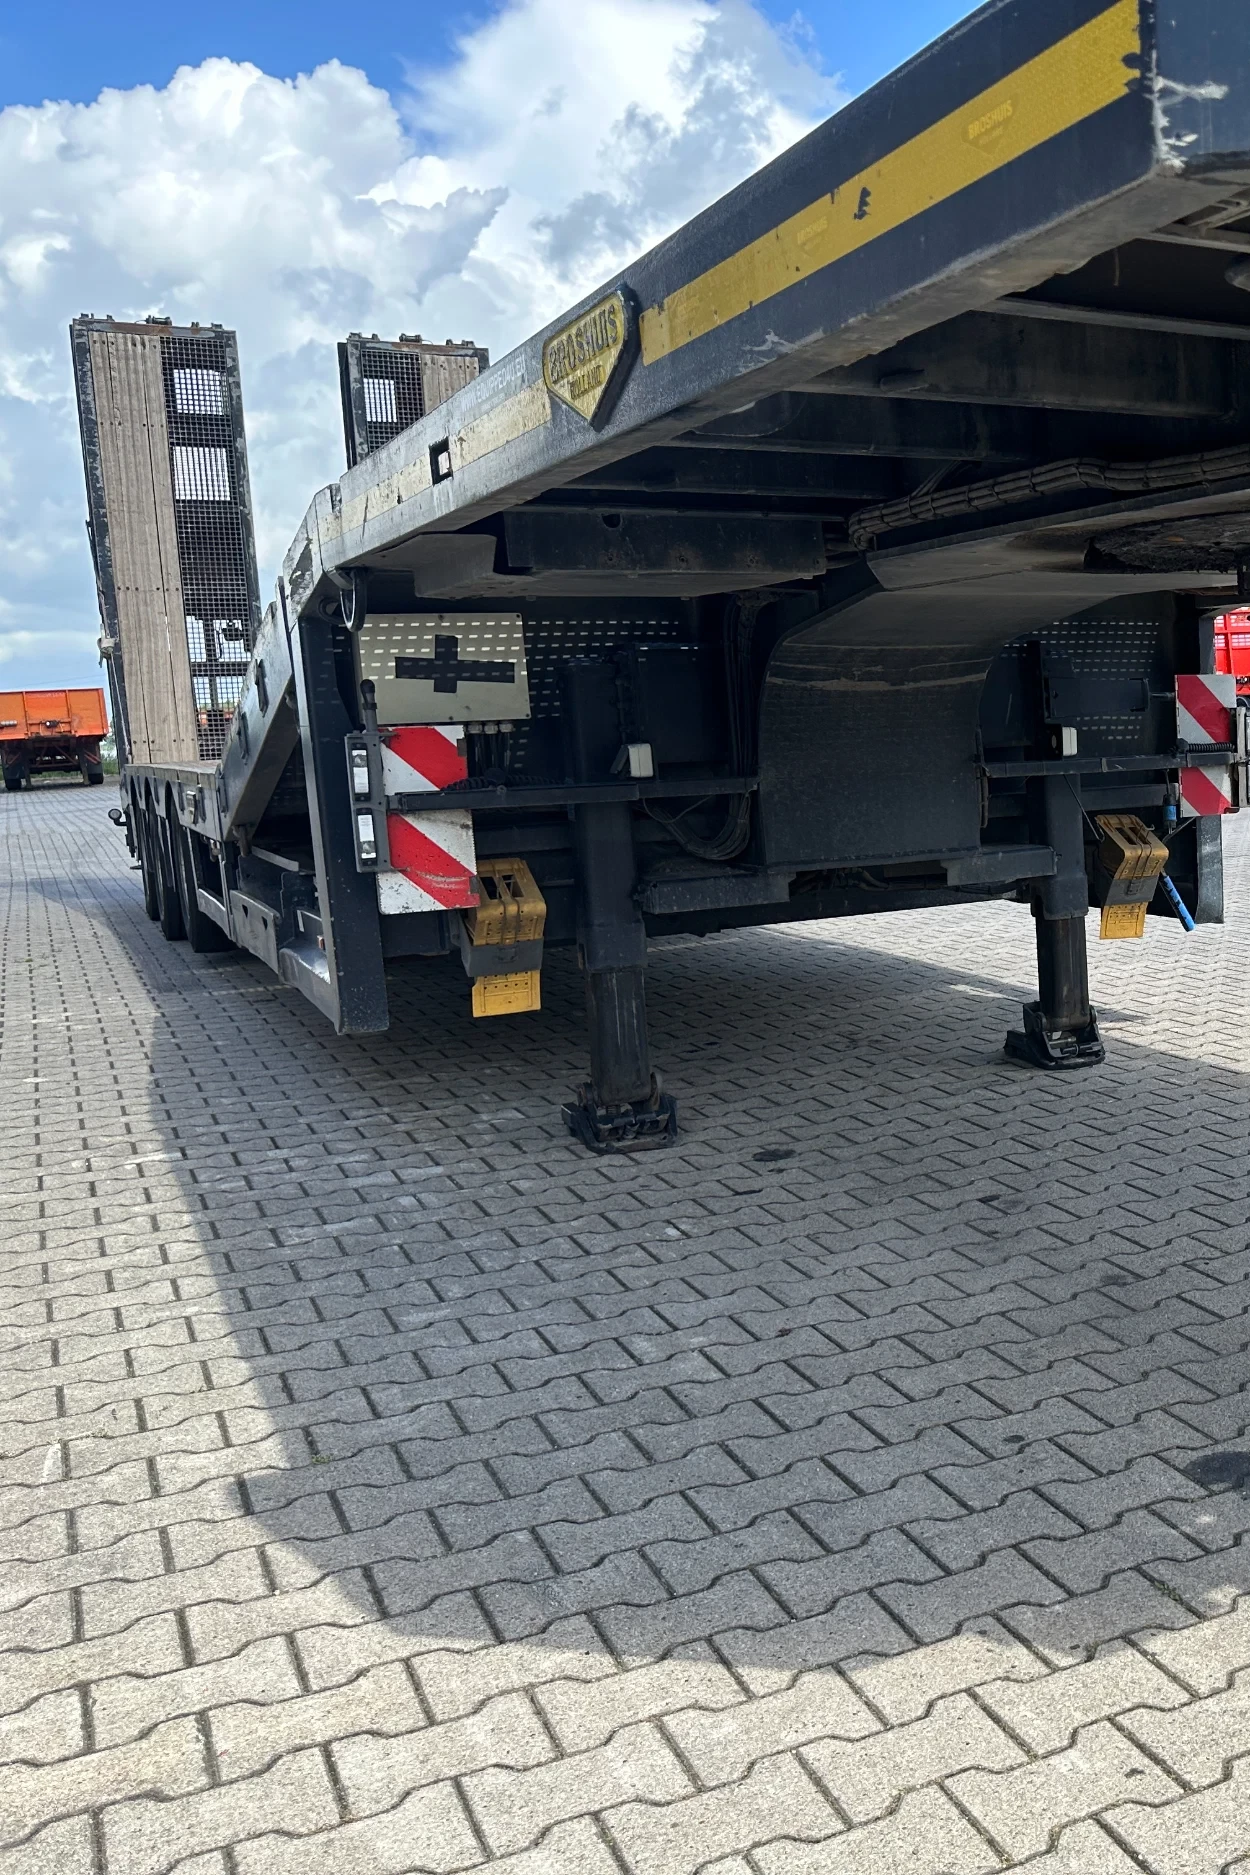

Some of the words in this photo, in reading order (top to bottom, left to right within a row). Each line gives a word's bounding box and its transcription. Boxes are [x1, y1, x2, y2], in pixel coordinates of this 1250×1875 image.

[968, 100, 1012, 140] BROSHUIS
[549, 304, 618, 385] BROSHUIS
[569, 364, 605, 401] HOLLAND
